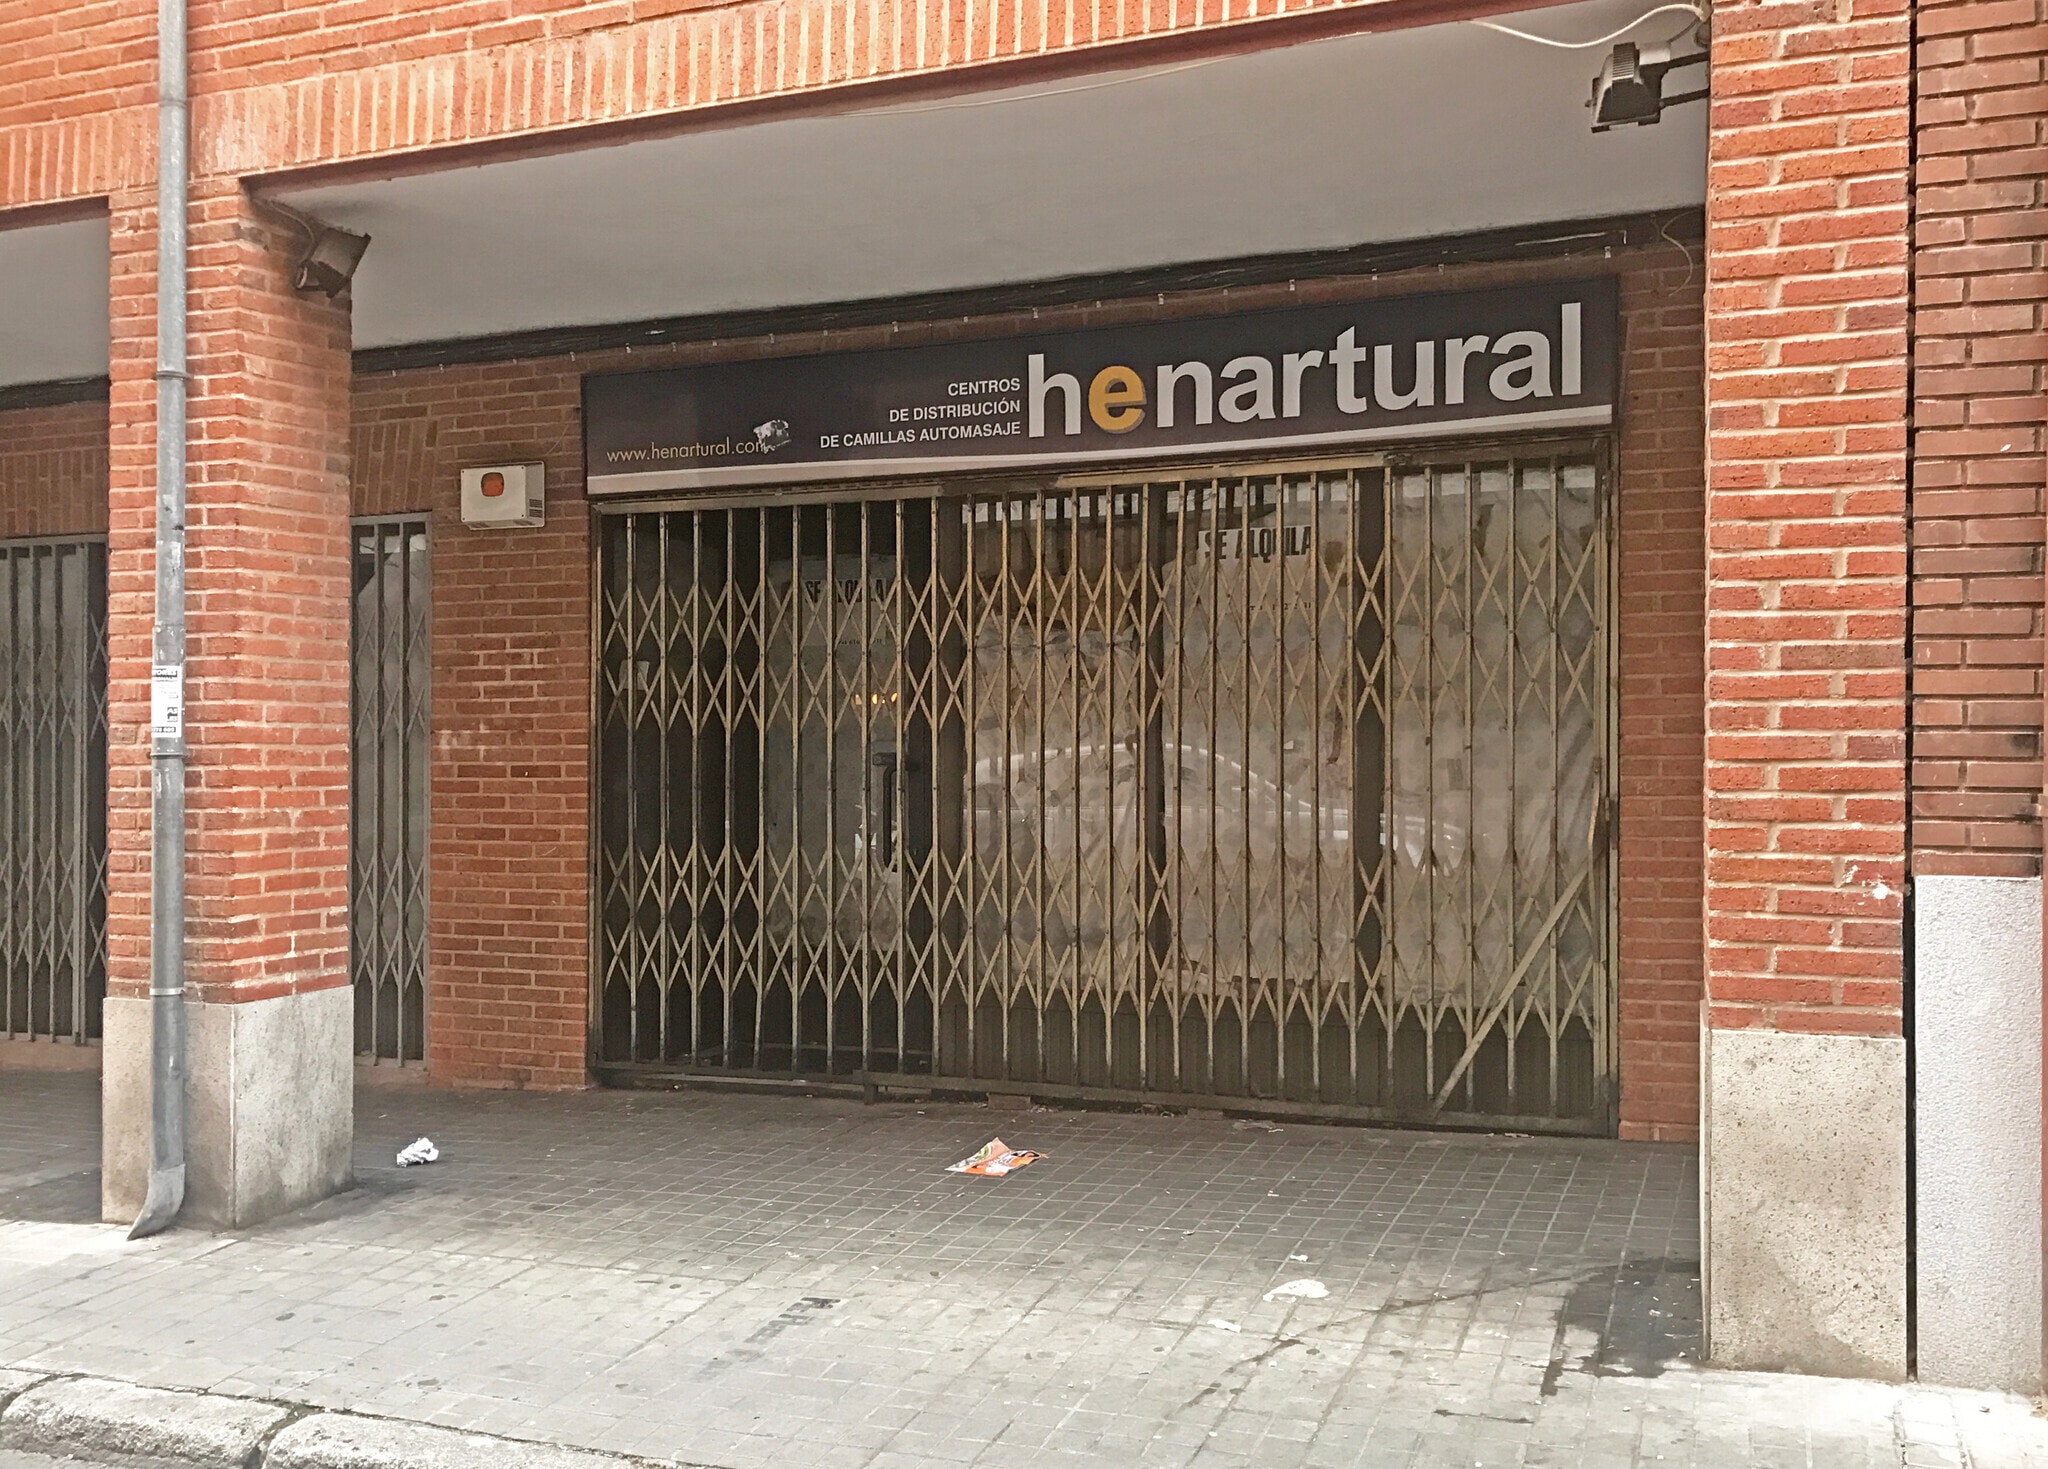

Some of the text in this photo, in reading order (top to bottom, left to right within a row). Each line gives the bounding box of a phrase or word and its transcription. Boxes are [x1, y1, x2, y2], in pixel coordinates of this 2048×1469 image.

[1027, 302, 1582, 438] henartural
[947, 377, 1021, 396] CENTROS
[889, 397, 1021, 422] DE DISTRIBUCIÓN
[820, 421, 1021, 448] DE CAMILLAS AUTOMASAJE
